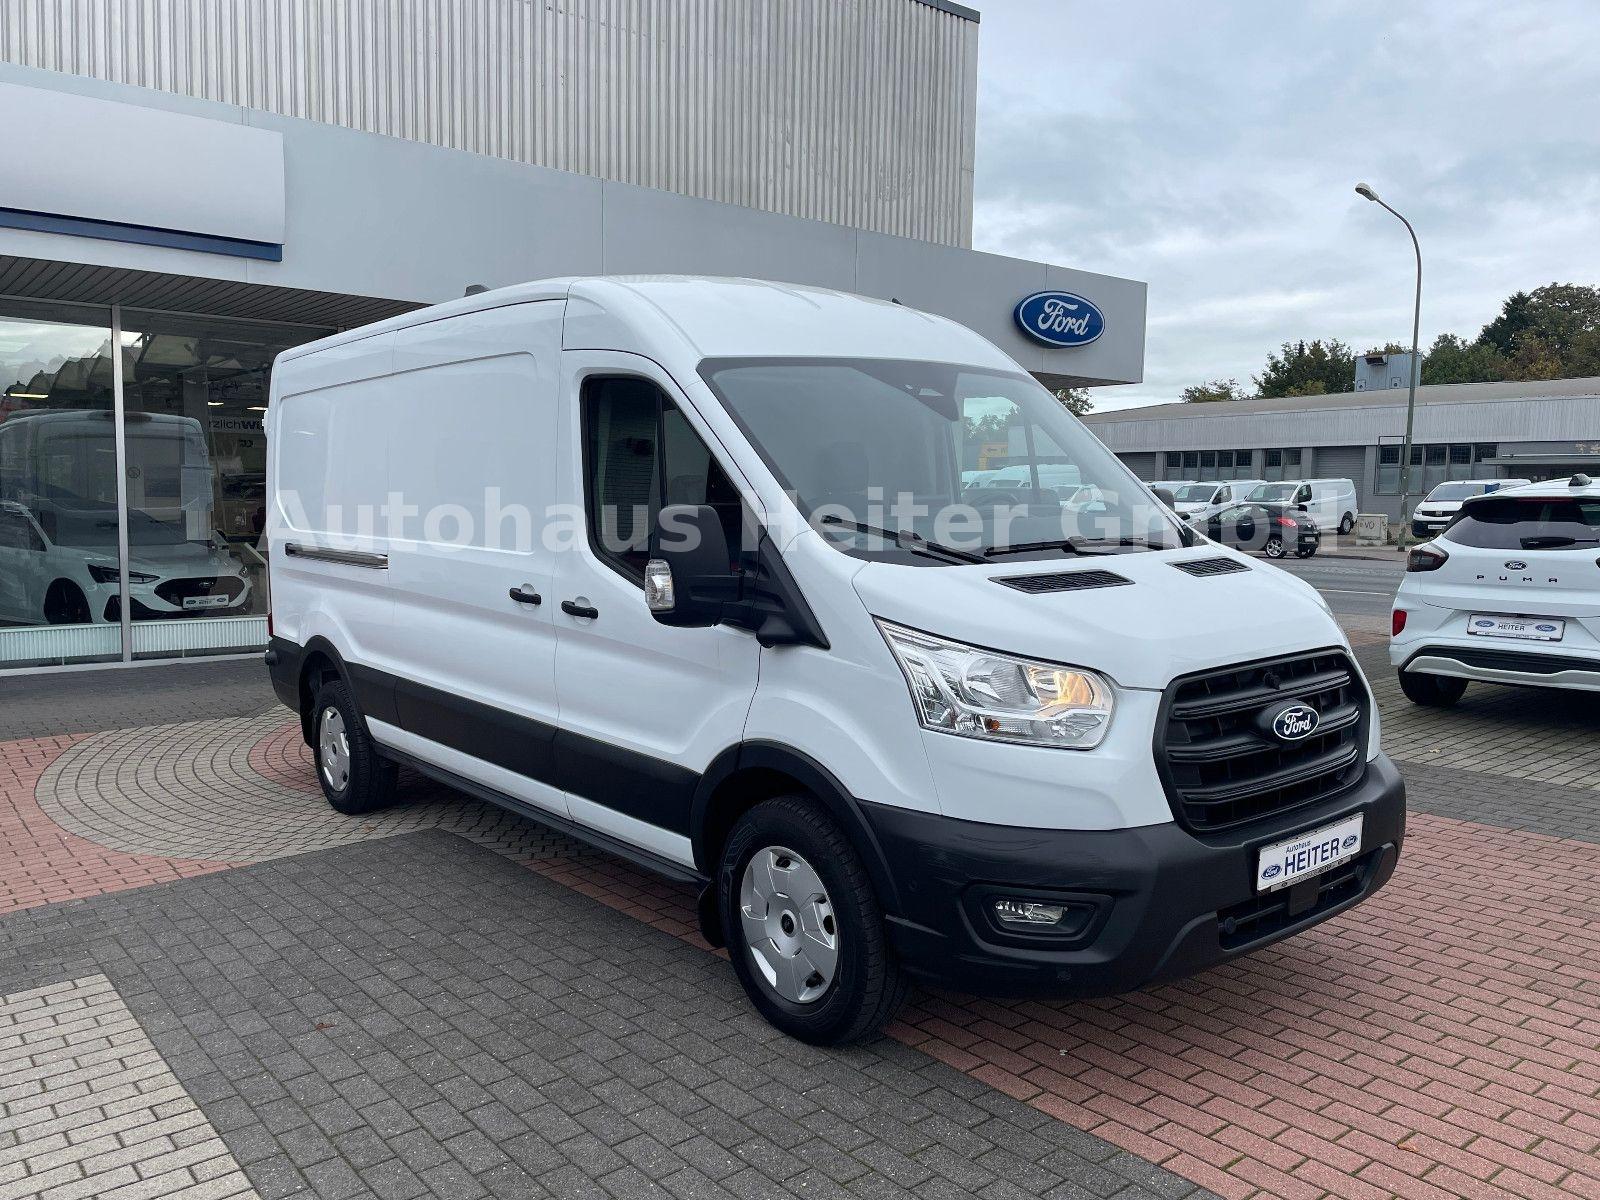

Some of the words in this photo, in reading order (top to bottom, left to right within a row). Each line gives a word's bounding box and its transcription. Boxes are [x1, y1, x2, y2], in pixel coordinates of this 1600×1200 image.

[1037, 298, 1091, 336] Ford
[1476, 574, 1558, 583] PUMA
[1497, 623, 1526, 632] HEITER
[1283, 711, 1312, 735] Ford
[1285, 841, 1311, 854] Autohaus
[1284, 837, 1340, 877] HEITER
